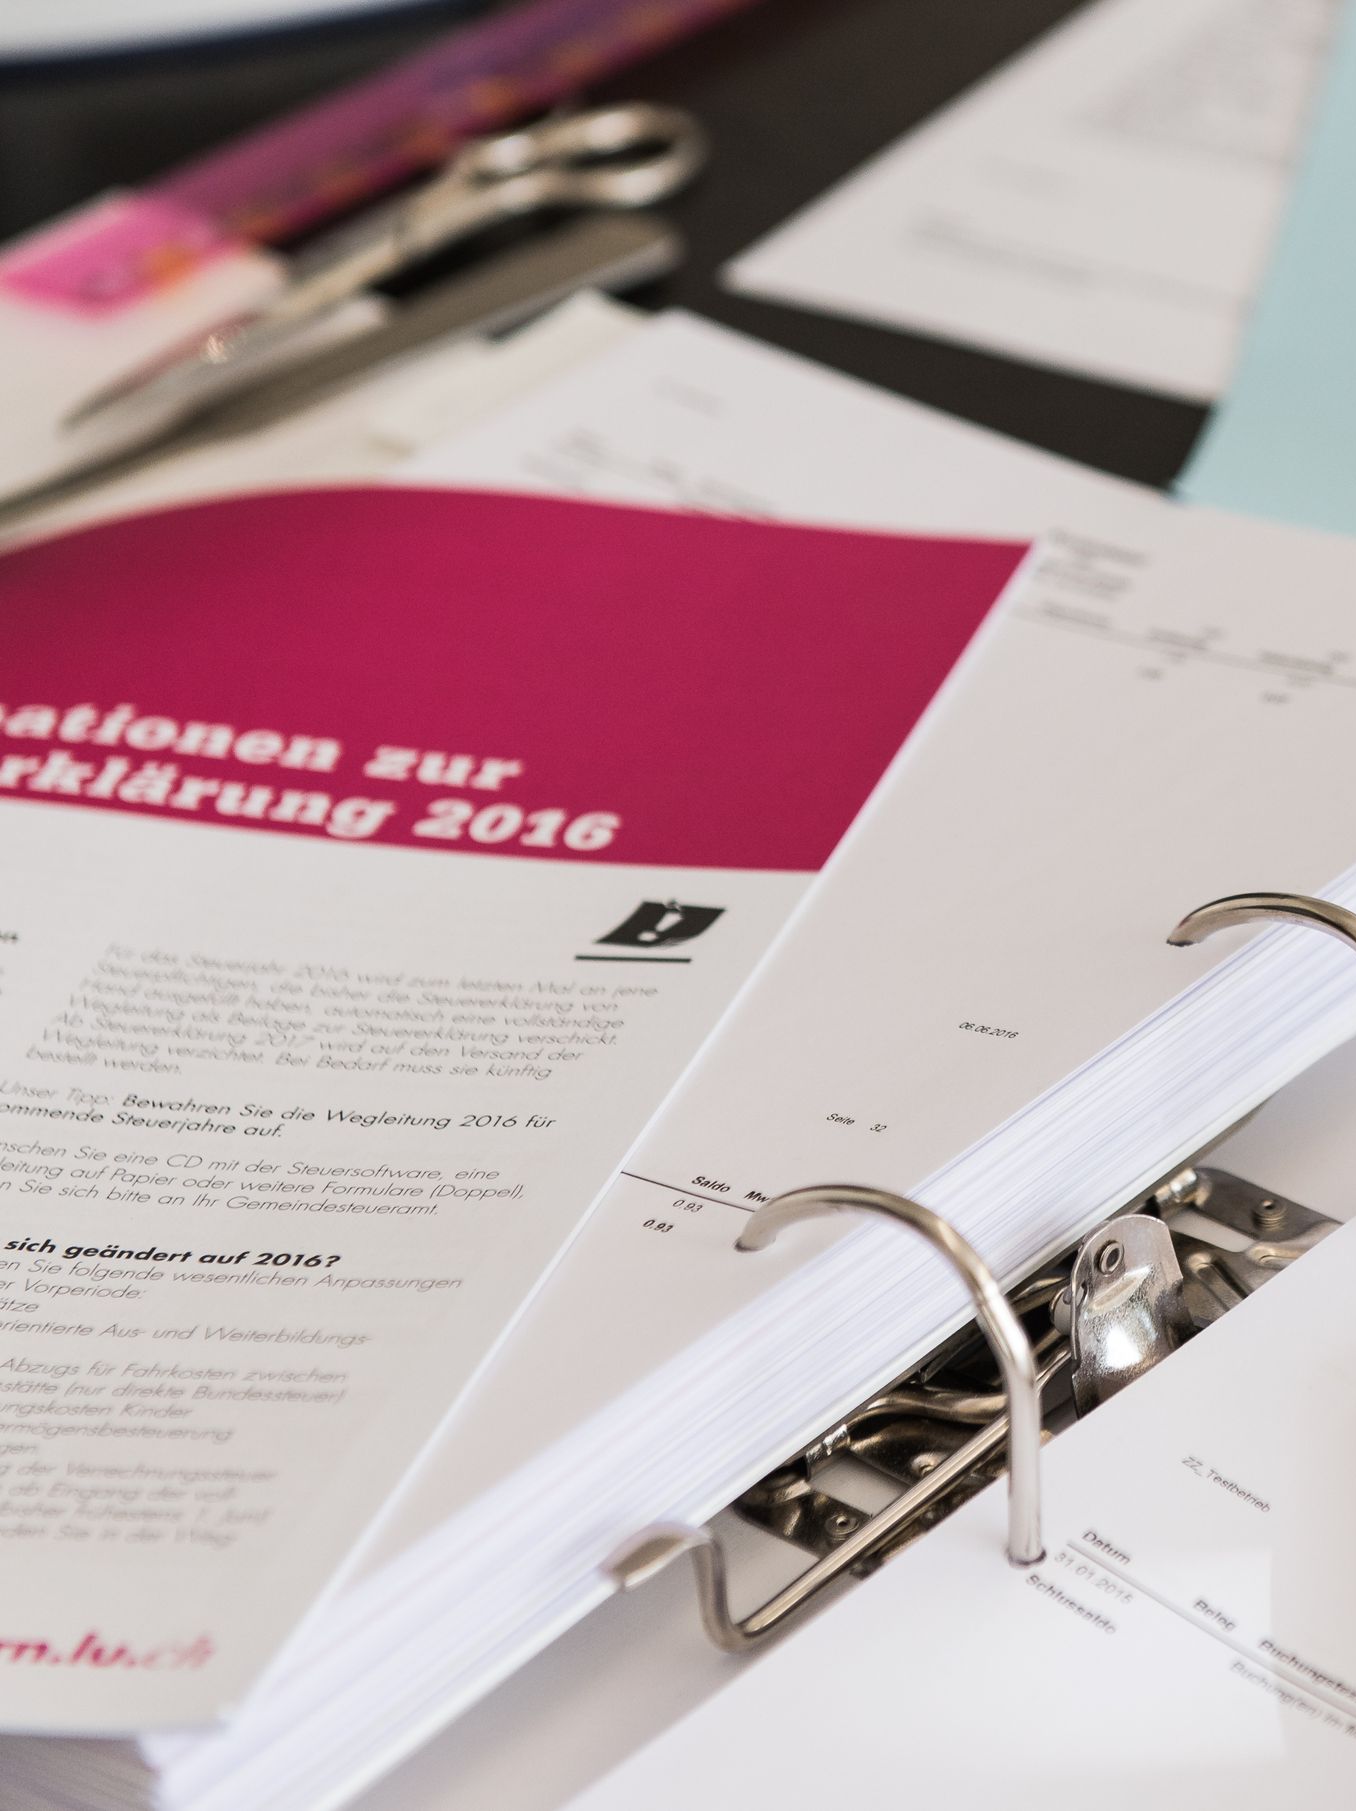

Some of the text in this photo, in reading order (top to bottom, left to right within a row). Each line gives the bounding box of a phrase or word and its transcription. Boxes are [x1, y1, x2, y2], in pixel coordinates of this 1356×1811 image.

[0, 702, 525, 791] ationen zur
[0, 749, 622, 852] rklärung 2016
[393, 1061, 442, 1074] muss
[449, 1063, 479, 1077] sie
[486, 1064, 553, 1081] künftig
[0, 1080, 58, 1099] Unser
[123, 1093, 231, 1116] Bewahren
[239, 1103, 274, 1119] Sie
[281, 1106, 315, 1121] die
[327, 1108, 452, 1130] Wegleitung
[459, 1114, 518, 1129] 2016
[525, 1113, 558, 1129] für
[111, 1111, 236, 1135] Steuerjahre
[243, 1122, 283, 1138] auf.
[825, 1111, 888, 1134] Seite 32
[74, 1145, 107, 1161] Sie
[114, 1151, 158, 1166] eine
[166, 1153, 203, 1169] CD
[208, 1158, 240, 1172] mit
[245, 1159, 281, 1175] der
[287, 1161, 443, 1181] Steuersoftware,
[454, 1168, 500, 1180] eine
[19, 1179, 440, 1216] Sie sich bitte an Ihr Gemeindesteueramt.
[70, 1166, 110, 1181] auf
[110, 1167, 178, 1187] Papier
[182, 1174, 234, 1190] oder
[240, 1178, 315, 1195] weitere
[321, 1181, 424, 1198] Formulare
[430, 1183, 525, 1202] (Doppel),
[691, 1175, 770, 1204] Saldo Mw
[672, 1198, 704, 1214] 0.93
[642, 1218, 674, 1234] 0.93
[4, 1237, 342, 1269] sich geändert auf 2016?
[23, 1278, 148, 1299] Vorperiode:
[27, 1258, 464, 1293] Sie folgende wesentlichen Anpassungen
[99, 1322, 146, 1338] Aus-
[152, 1325, 199, 1340] und
[204, 1325, 375, 1349] Weiterbildungs-
[0, 1357, 347, 1384] Abzugs für Fahrkosten zwischen
[111, 1380, 184, 1400] direkte
[119, 1402, 192, 1419] Kinder
[1081, 1529, 1133, 1566] Datum
[1192, 1596, 1238, 1633] Beleg
